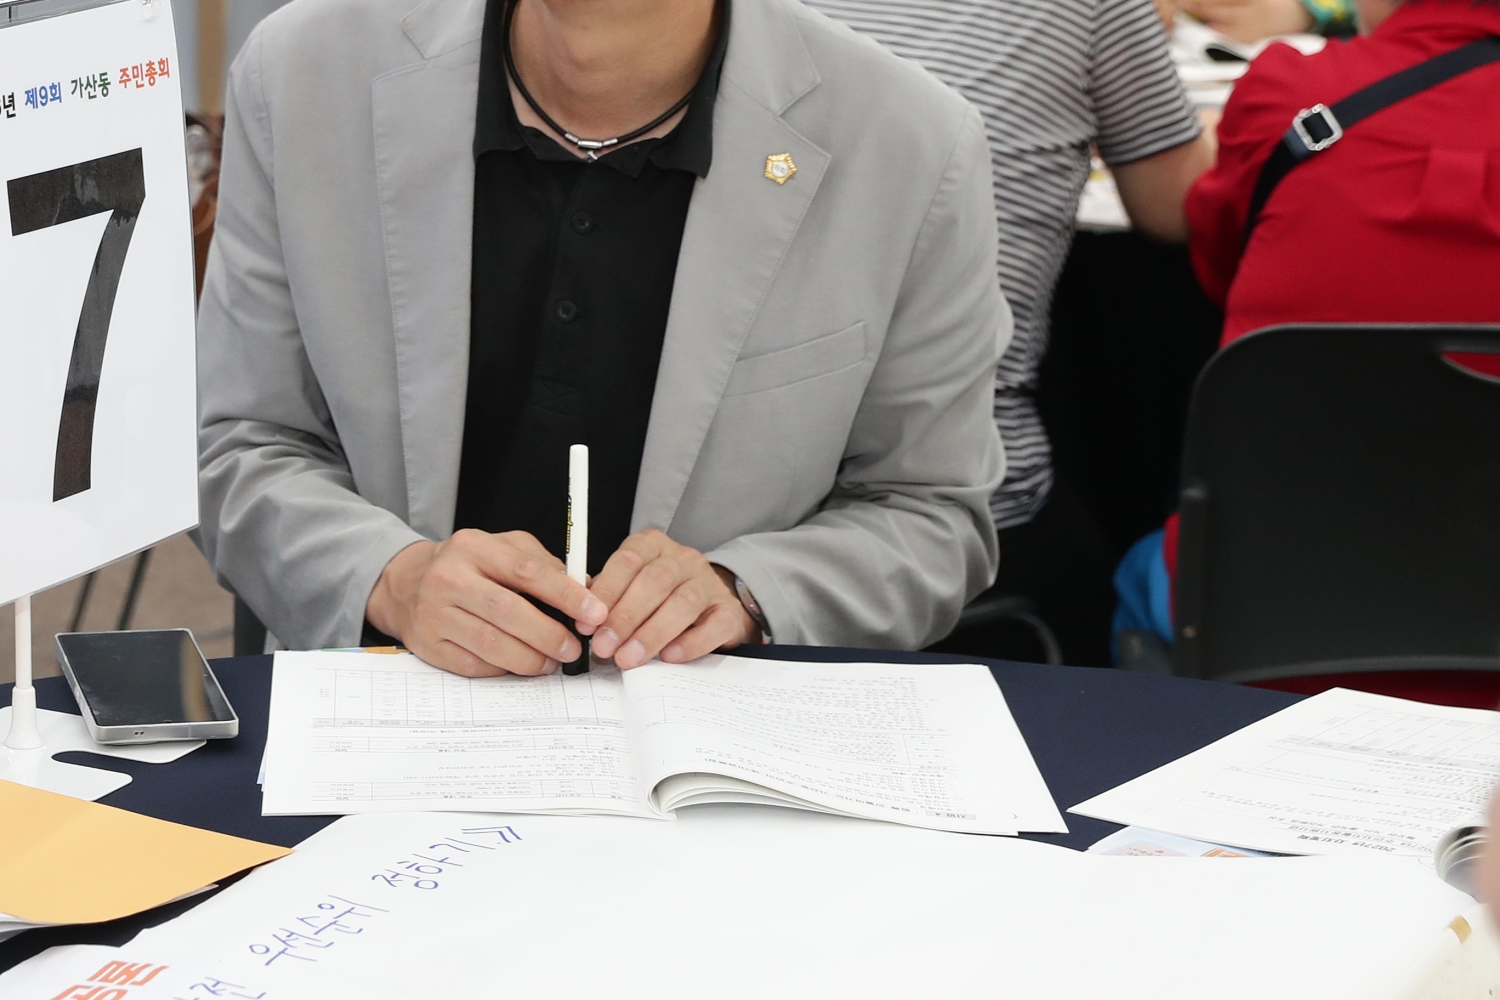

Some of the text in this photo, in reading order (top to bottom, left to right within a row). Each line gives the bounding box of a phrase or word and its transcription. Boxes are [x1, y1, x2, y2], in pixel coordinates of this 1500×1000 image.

[24, 81, 63, 109] 제9회
[70, 71, 111, 100] 가산동
[118, 57, 171, 90] 주민총회
[7, 147, 146, 502] 7
[173, 976, 267, 1000] 전
[249, 893, 390, 966] 우선순위
